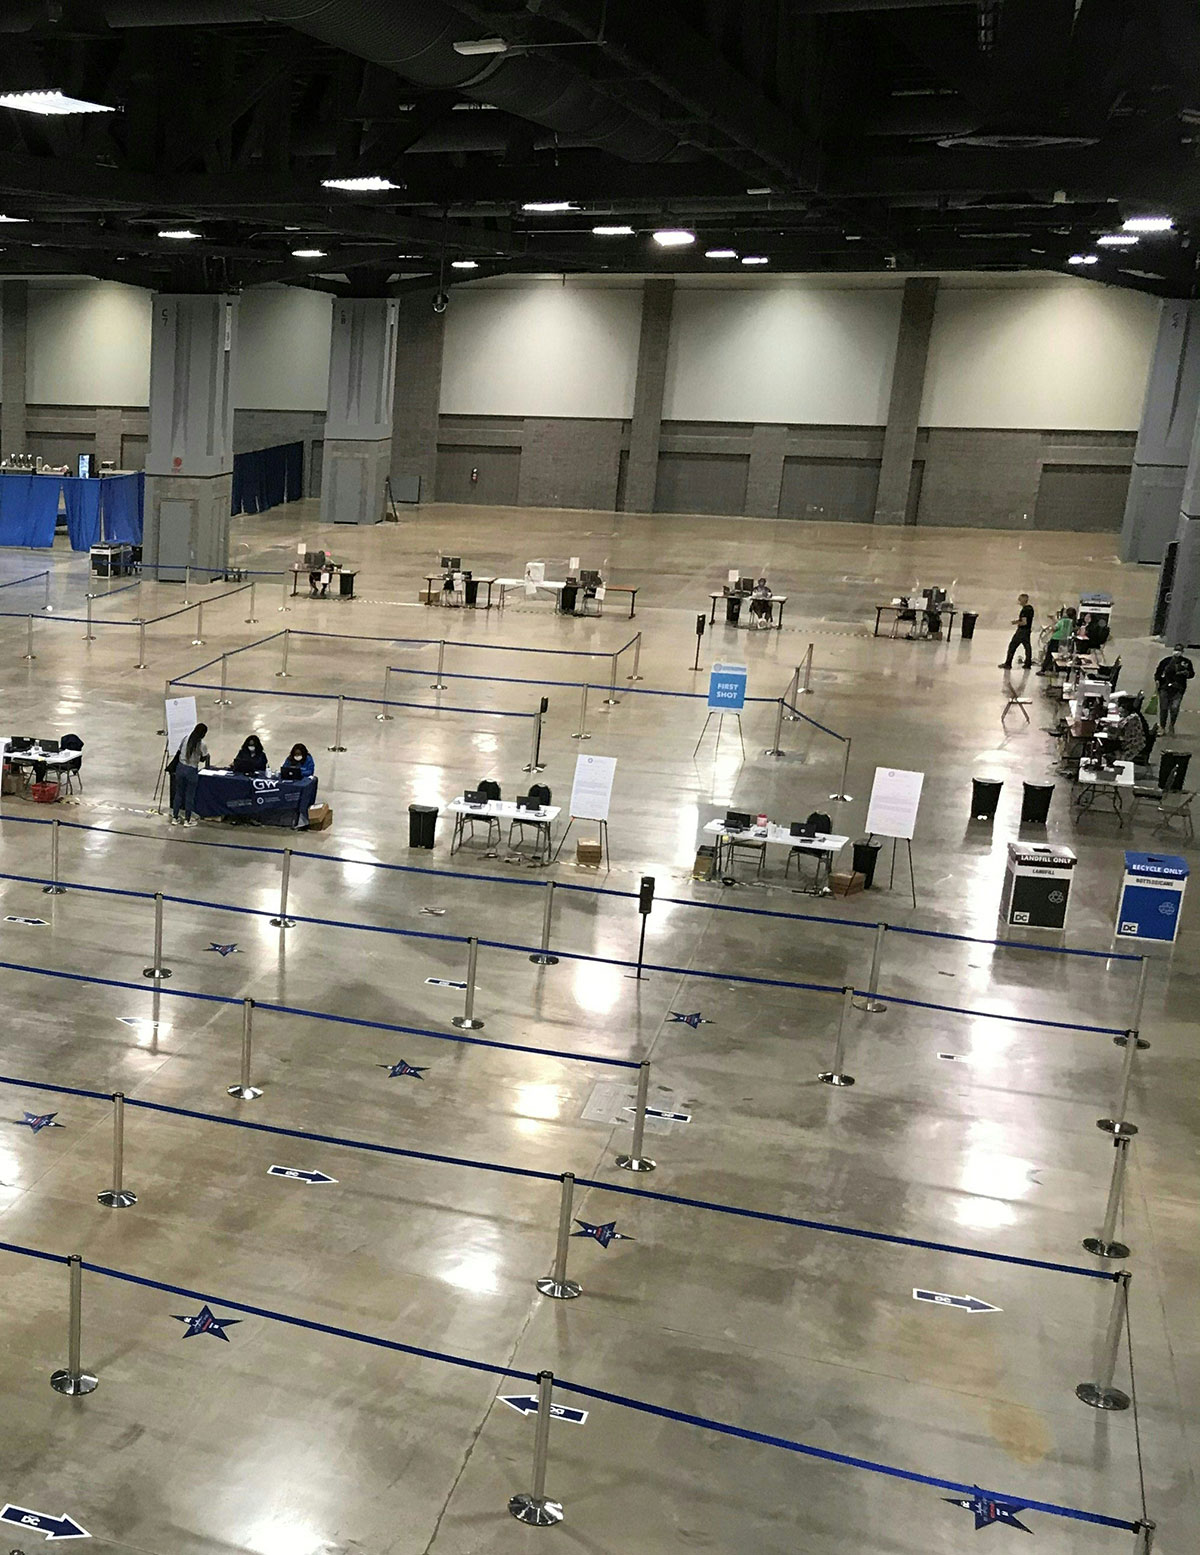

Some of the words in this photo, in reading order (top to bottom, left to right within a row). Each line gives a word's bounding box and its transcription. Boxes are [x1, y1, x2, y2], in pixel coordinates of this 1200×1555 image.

[717, 683, 739, 691] FIRST
[716, 691, 738, 699] SHOT
[253, 779, 279, 790] GW
[1021, 855, 1050, 863] LANDFILL
[1132, 864, 1161, 873] RECYCLE
[1163, 867, 1183, 875] ONLY
[1015, 914, 1028, 922] DC
[1123, 924, 1136, 932] DC
[20, 1515, 40, 1526] DC
